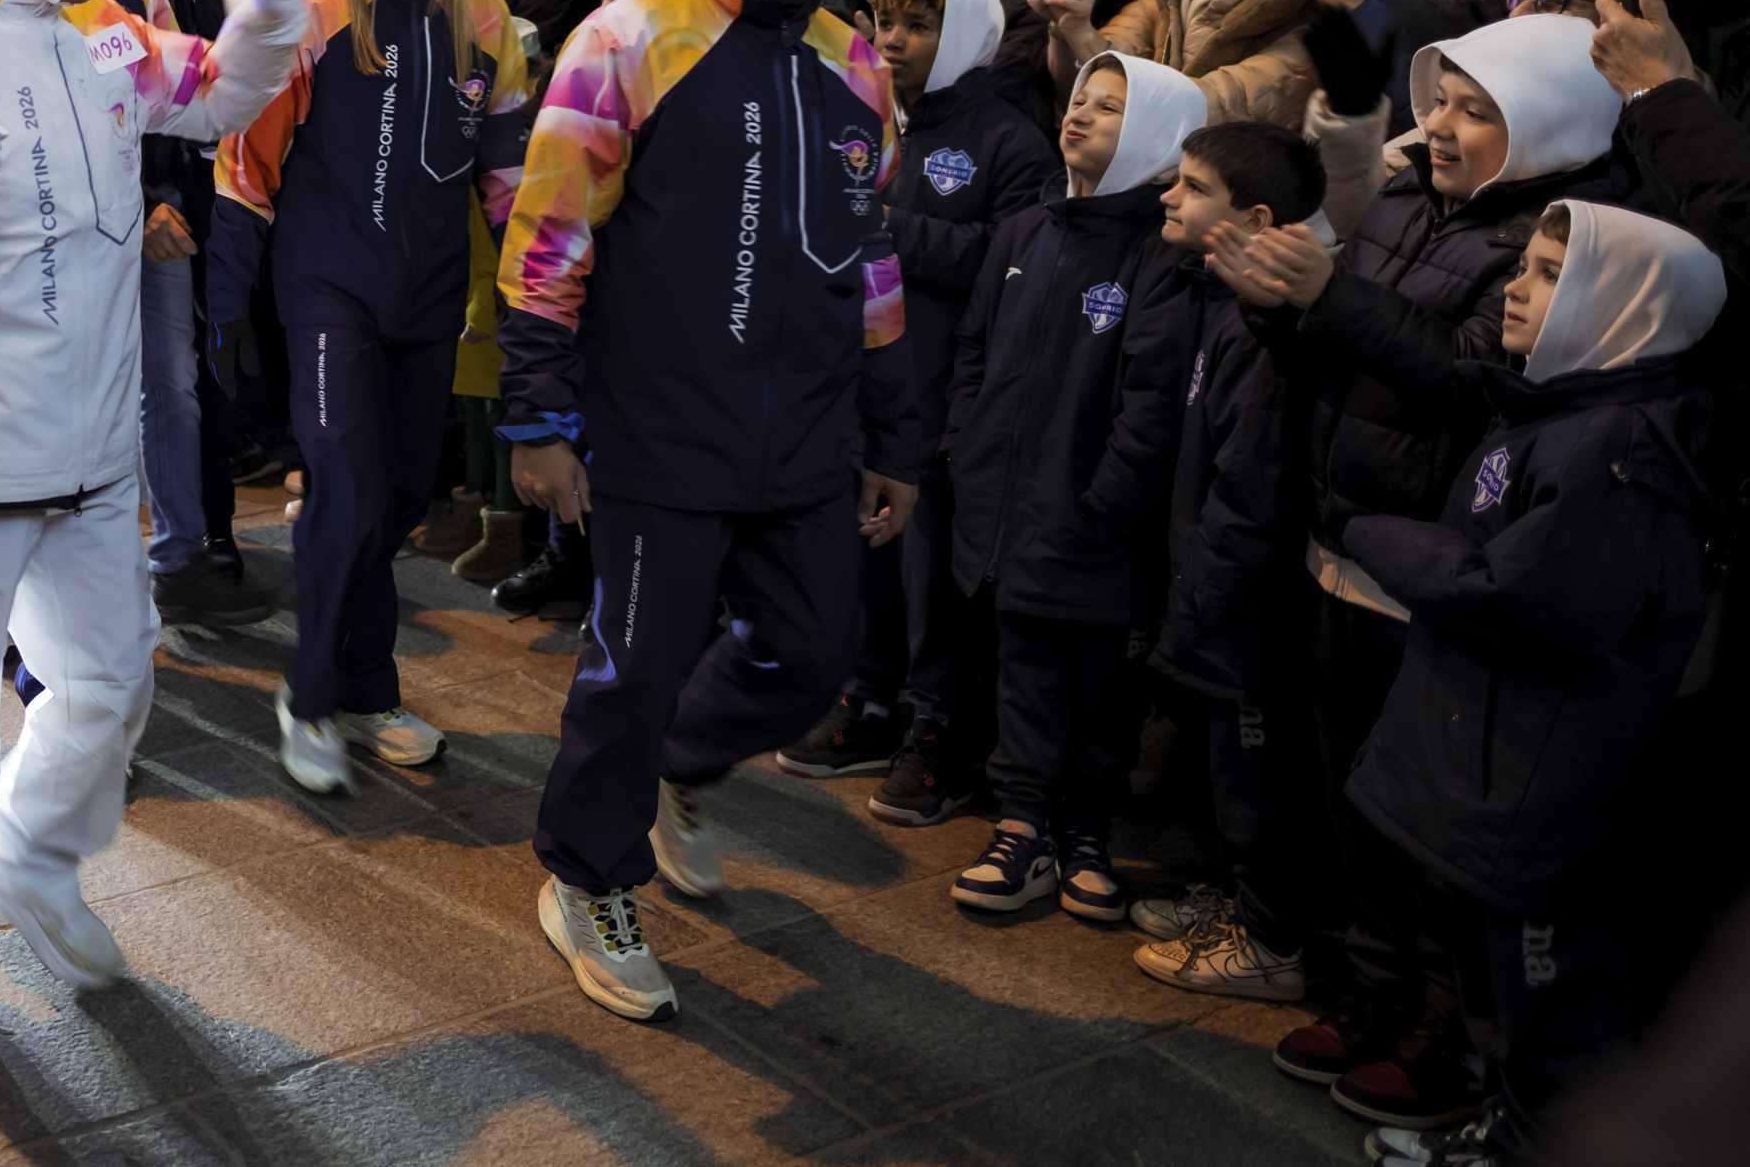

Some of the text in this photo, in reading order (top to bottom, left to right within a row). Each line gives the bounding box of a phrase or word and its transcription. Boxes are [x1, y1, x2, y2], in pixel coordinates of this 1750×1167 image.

[88, 30, 133, 64] M096
[371, 44, 399, 232] MILANO CORTINA 2026
[930, 164, 968, 178] SONDRIO
[16, 85, 60, 327] MILANO CORTINA 2026
[728, 101, 762, 345] MILANO CORTINA 2026
[318, 332, 327, 427] MILANO CORTINA 2026
[624, 534, 643, 648] MILANO CORTINA 2026
